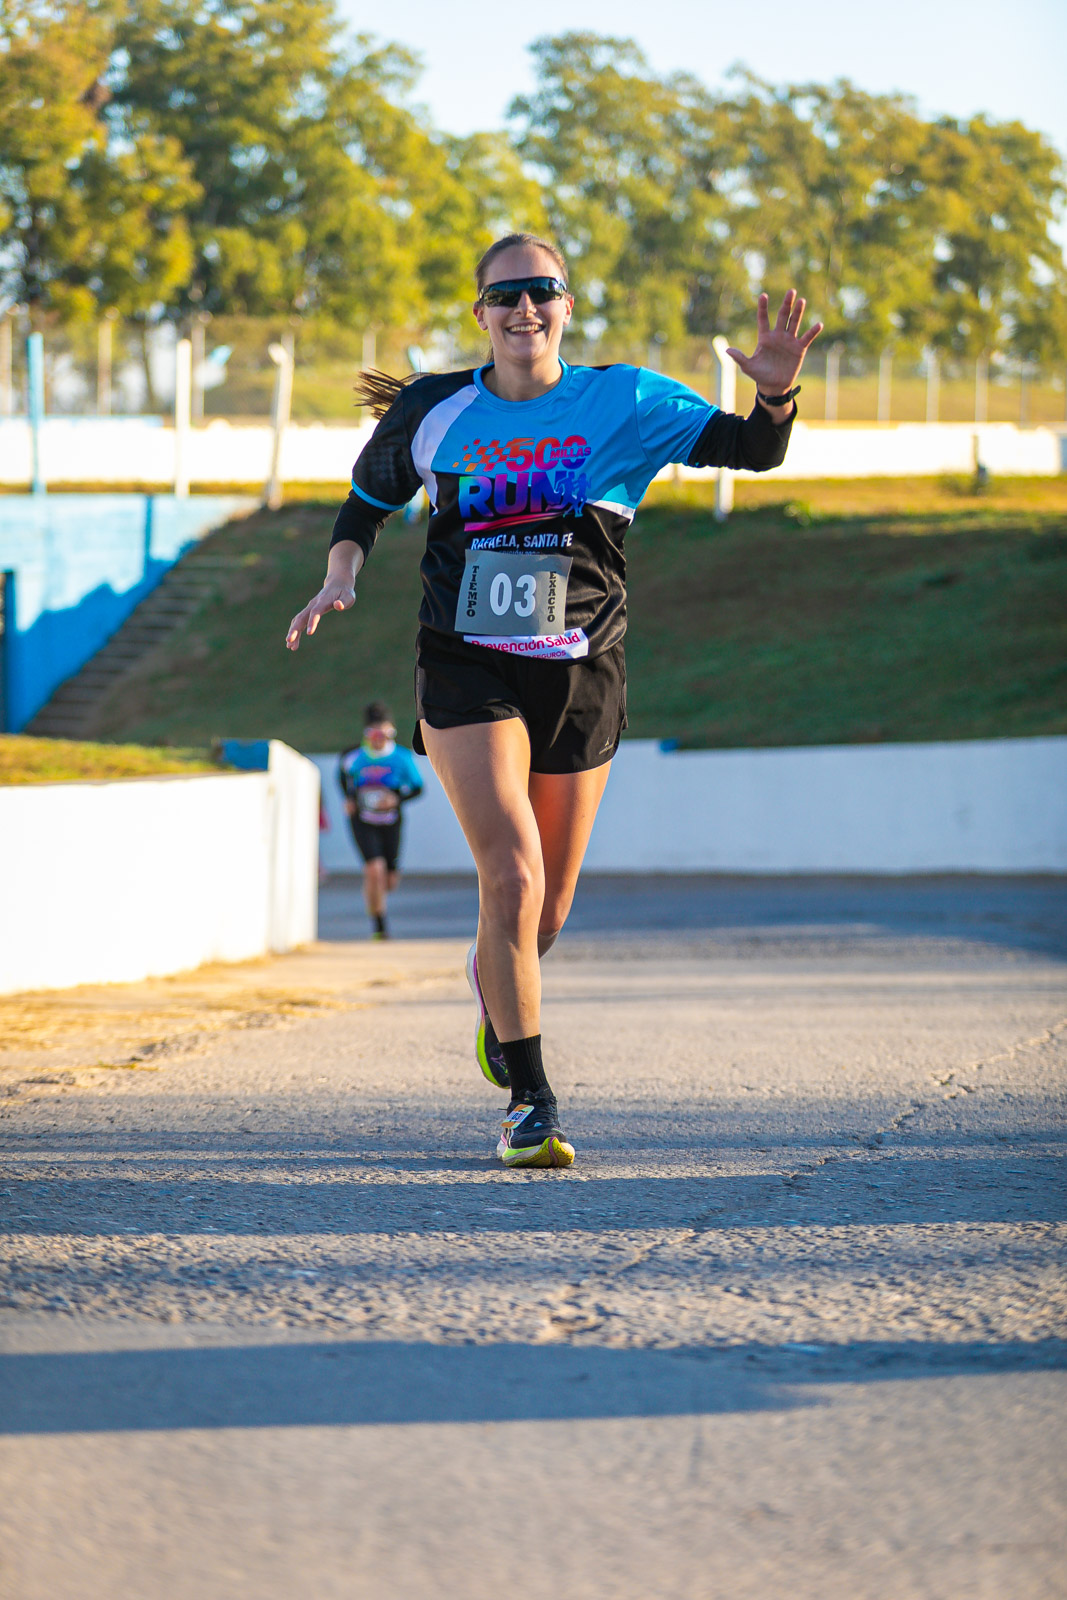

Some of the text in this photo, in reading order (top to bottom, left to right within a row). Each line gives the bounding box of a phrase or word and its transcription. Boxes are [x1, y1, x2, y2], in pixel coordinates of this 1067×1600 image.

[506, 435, 587, 472] 500
[551, 447, 592, 458] MILLAS
[459, 471, 566, 518] RUN
[471, 532, 574, 550] RAFAELA, SANTA FE
[467, 565, 480, 618] TIEMPO
[490, 572, 537, 618] 03
[547, 571, 557, 623] EXACTO
[545, 632, 581, 648] Salud
